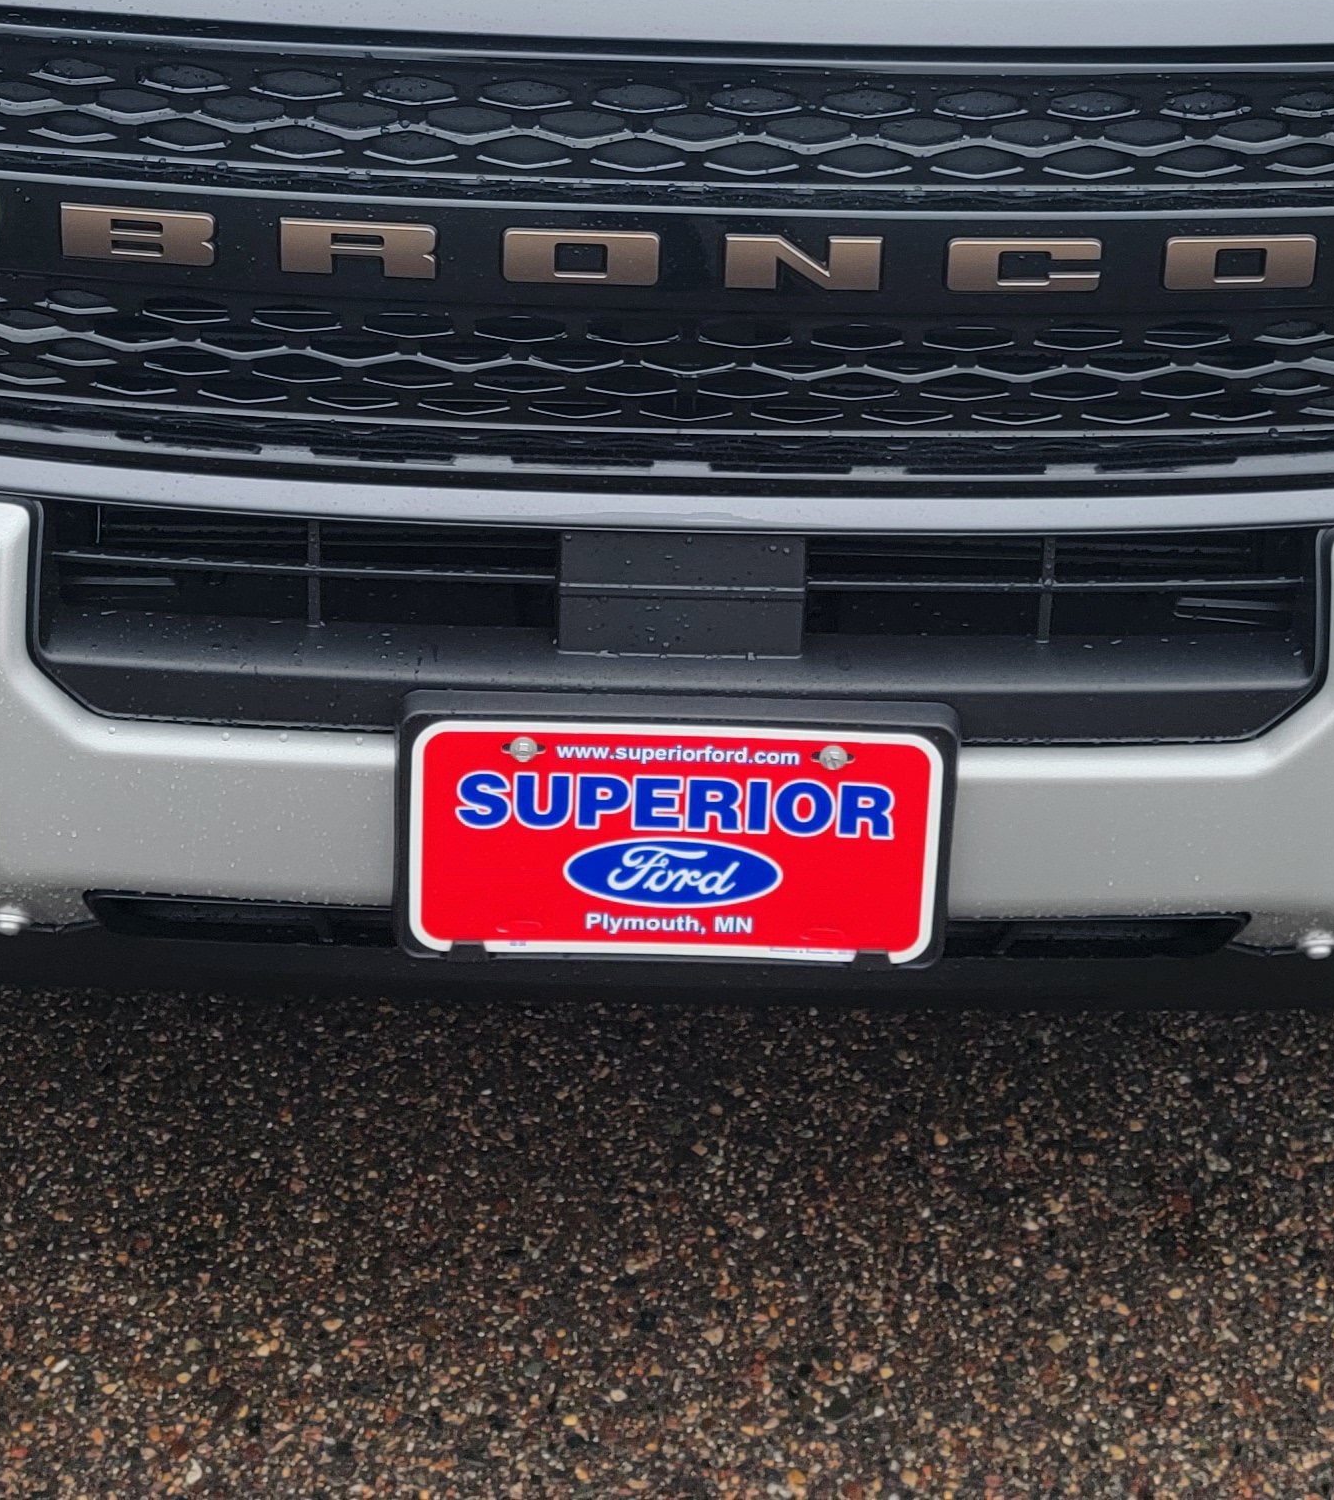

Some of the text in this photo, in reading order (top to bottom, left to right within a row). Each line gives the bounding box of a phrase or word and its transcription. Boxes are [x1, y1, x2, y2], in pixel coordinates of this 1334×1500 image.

[61, 203, 1316, 292] BRONCO
[556, 742, 800, 767] www.superiorford.com
[455, 771, 894, 840] SUPERIOR
[607, 846, 739, 896] Ford
[585, 912, 753, 935] Plymouth, MN
